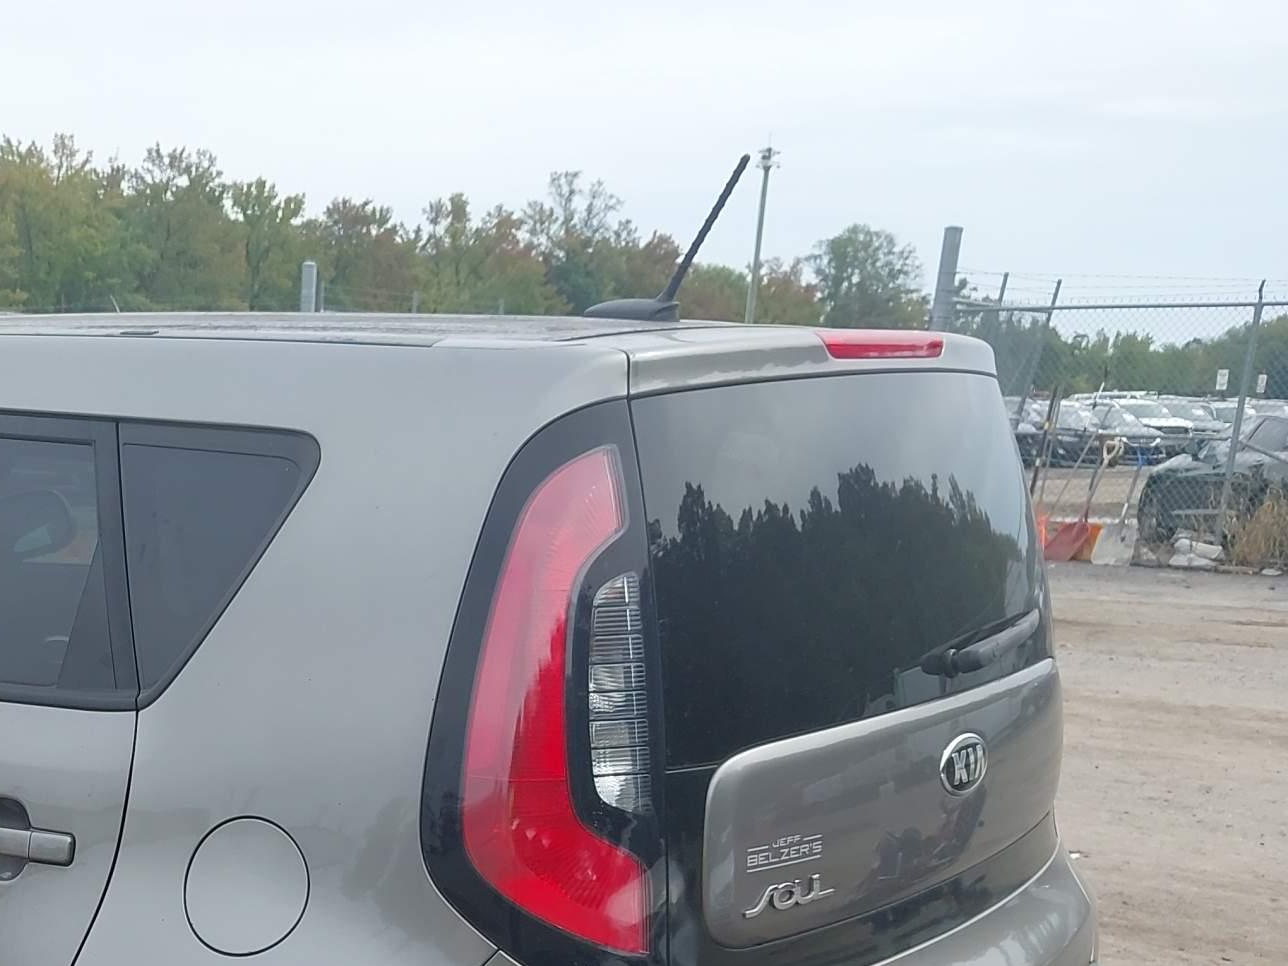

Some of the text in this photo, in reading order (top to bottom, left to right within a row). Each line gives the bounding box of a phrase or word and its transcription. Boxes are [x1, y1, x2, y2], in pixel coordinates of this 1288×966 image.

[951, 744, 985, 786] KIA
[746, 840, 823, 867] BELZER'S
[771, 834, 802, 849] JEFF
